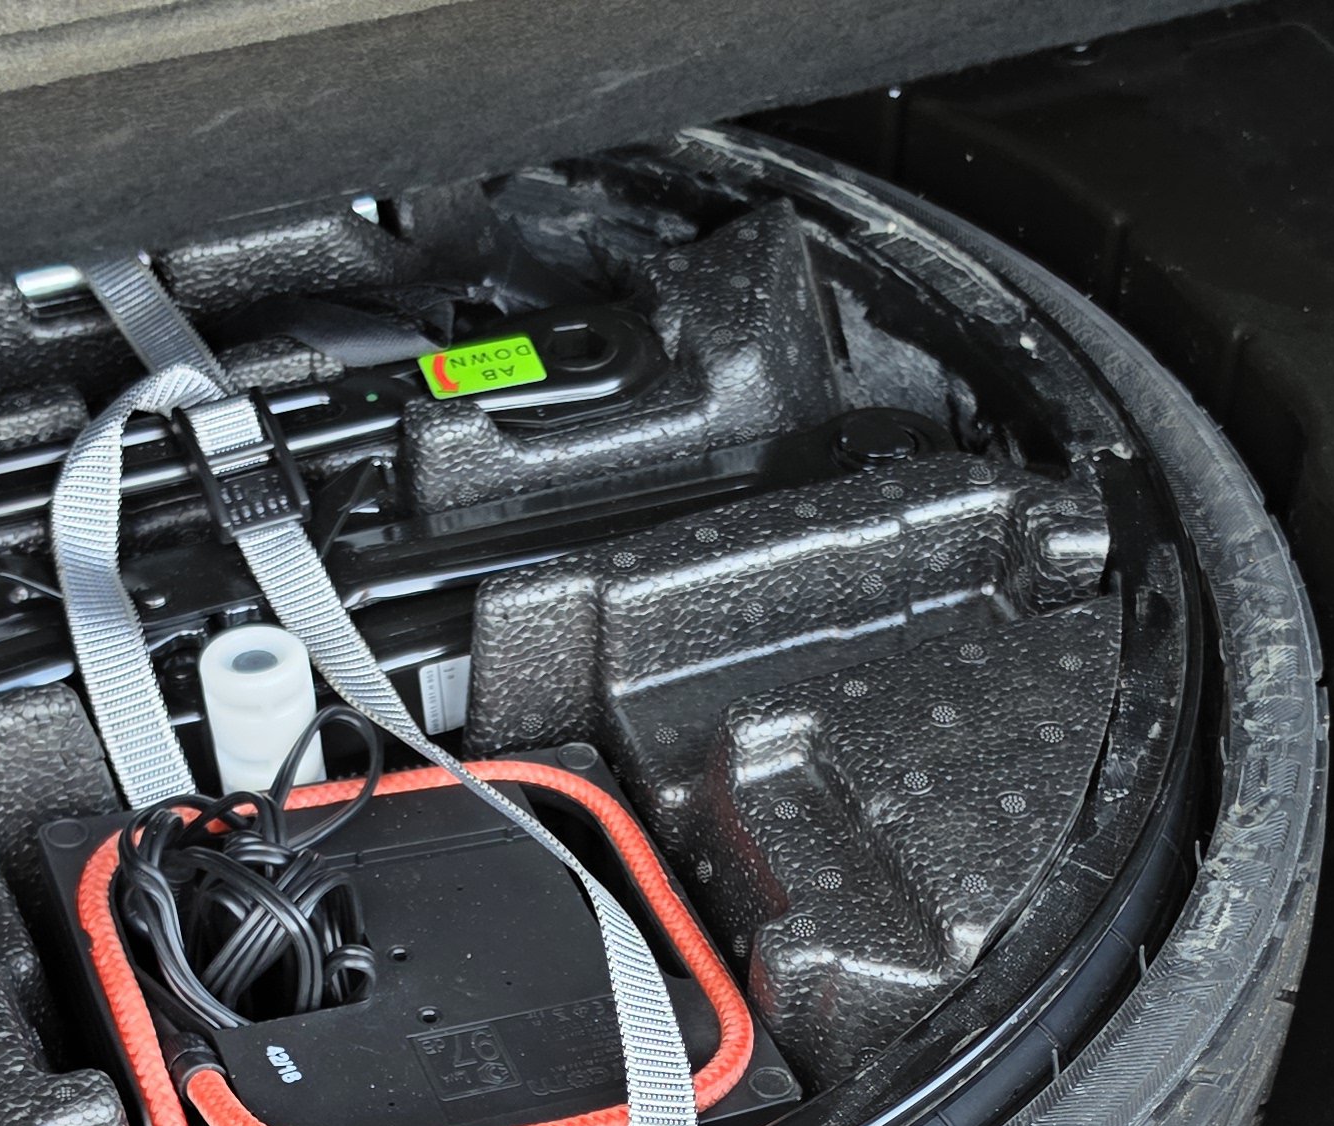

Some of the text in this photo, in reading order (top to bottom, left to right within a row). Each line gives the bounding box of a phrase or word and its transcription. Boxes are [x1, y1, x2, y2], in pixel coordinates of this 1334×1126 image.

[449, 344, 531, 369] DOWN
[481, 365, 515, 381] AB
[266, 1046, 302, 1083] 42/18
